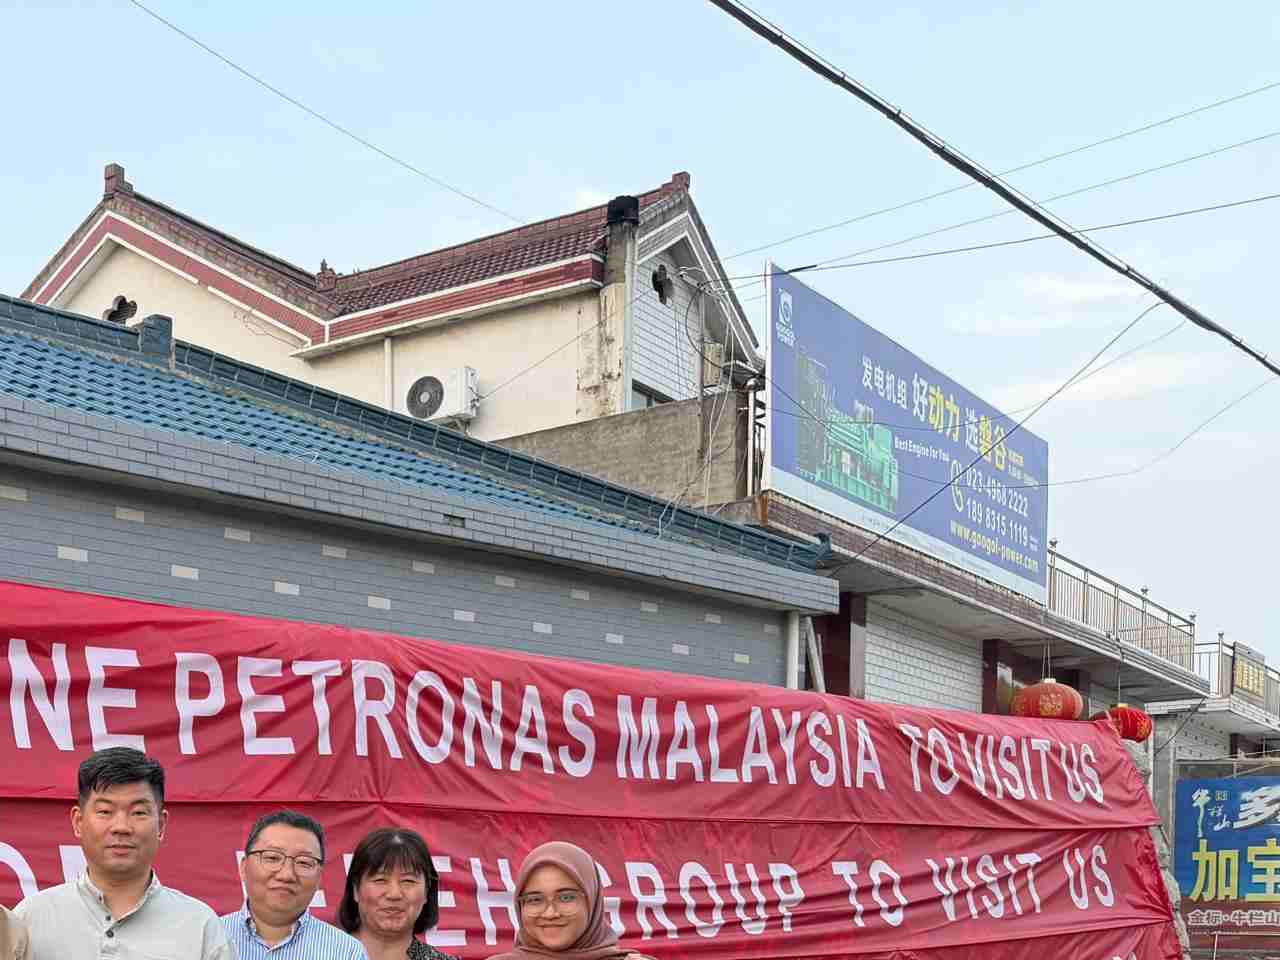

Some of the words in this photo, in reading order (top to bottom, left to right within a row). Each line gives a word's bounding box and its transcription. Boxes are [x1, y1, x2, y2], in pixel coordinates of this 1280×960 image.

[862, 355, 907, 409] 发电机组
[912, 372, 960, 442] 好动力
[966, 497, 983, 524] 189
[985, 507, 1007, 536] 8315
[1009, 520, 1028, 547] 1119
[1008, 487, 1028, 517] 2222
[174, 652, 597, 778] PETRONAS
[616, 694, 886, 790] MALAYSIA
[899, 723, 960, 796] TO
[958, 733, 1053, 801] VISIT
[1058, 741, 1105, 804] US
[832, 858, 910, 928] TO
[925, 852, 1042, 922] VISIT
[1062, 844, 1115, 910] US
